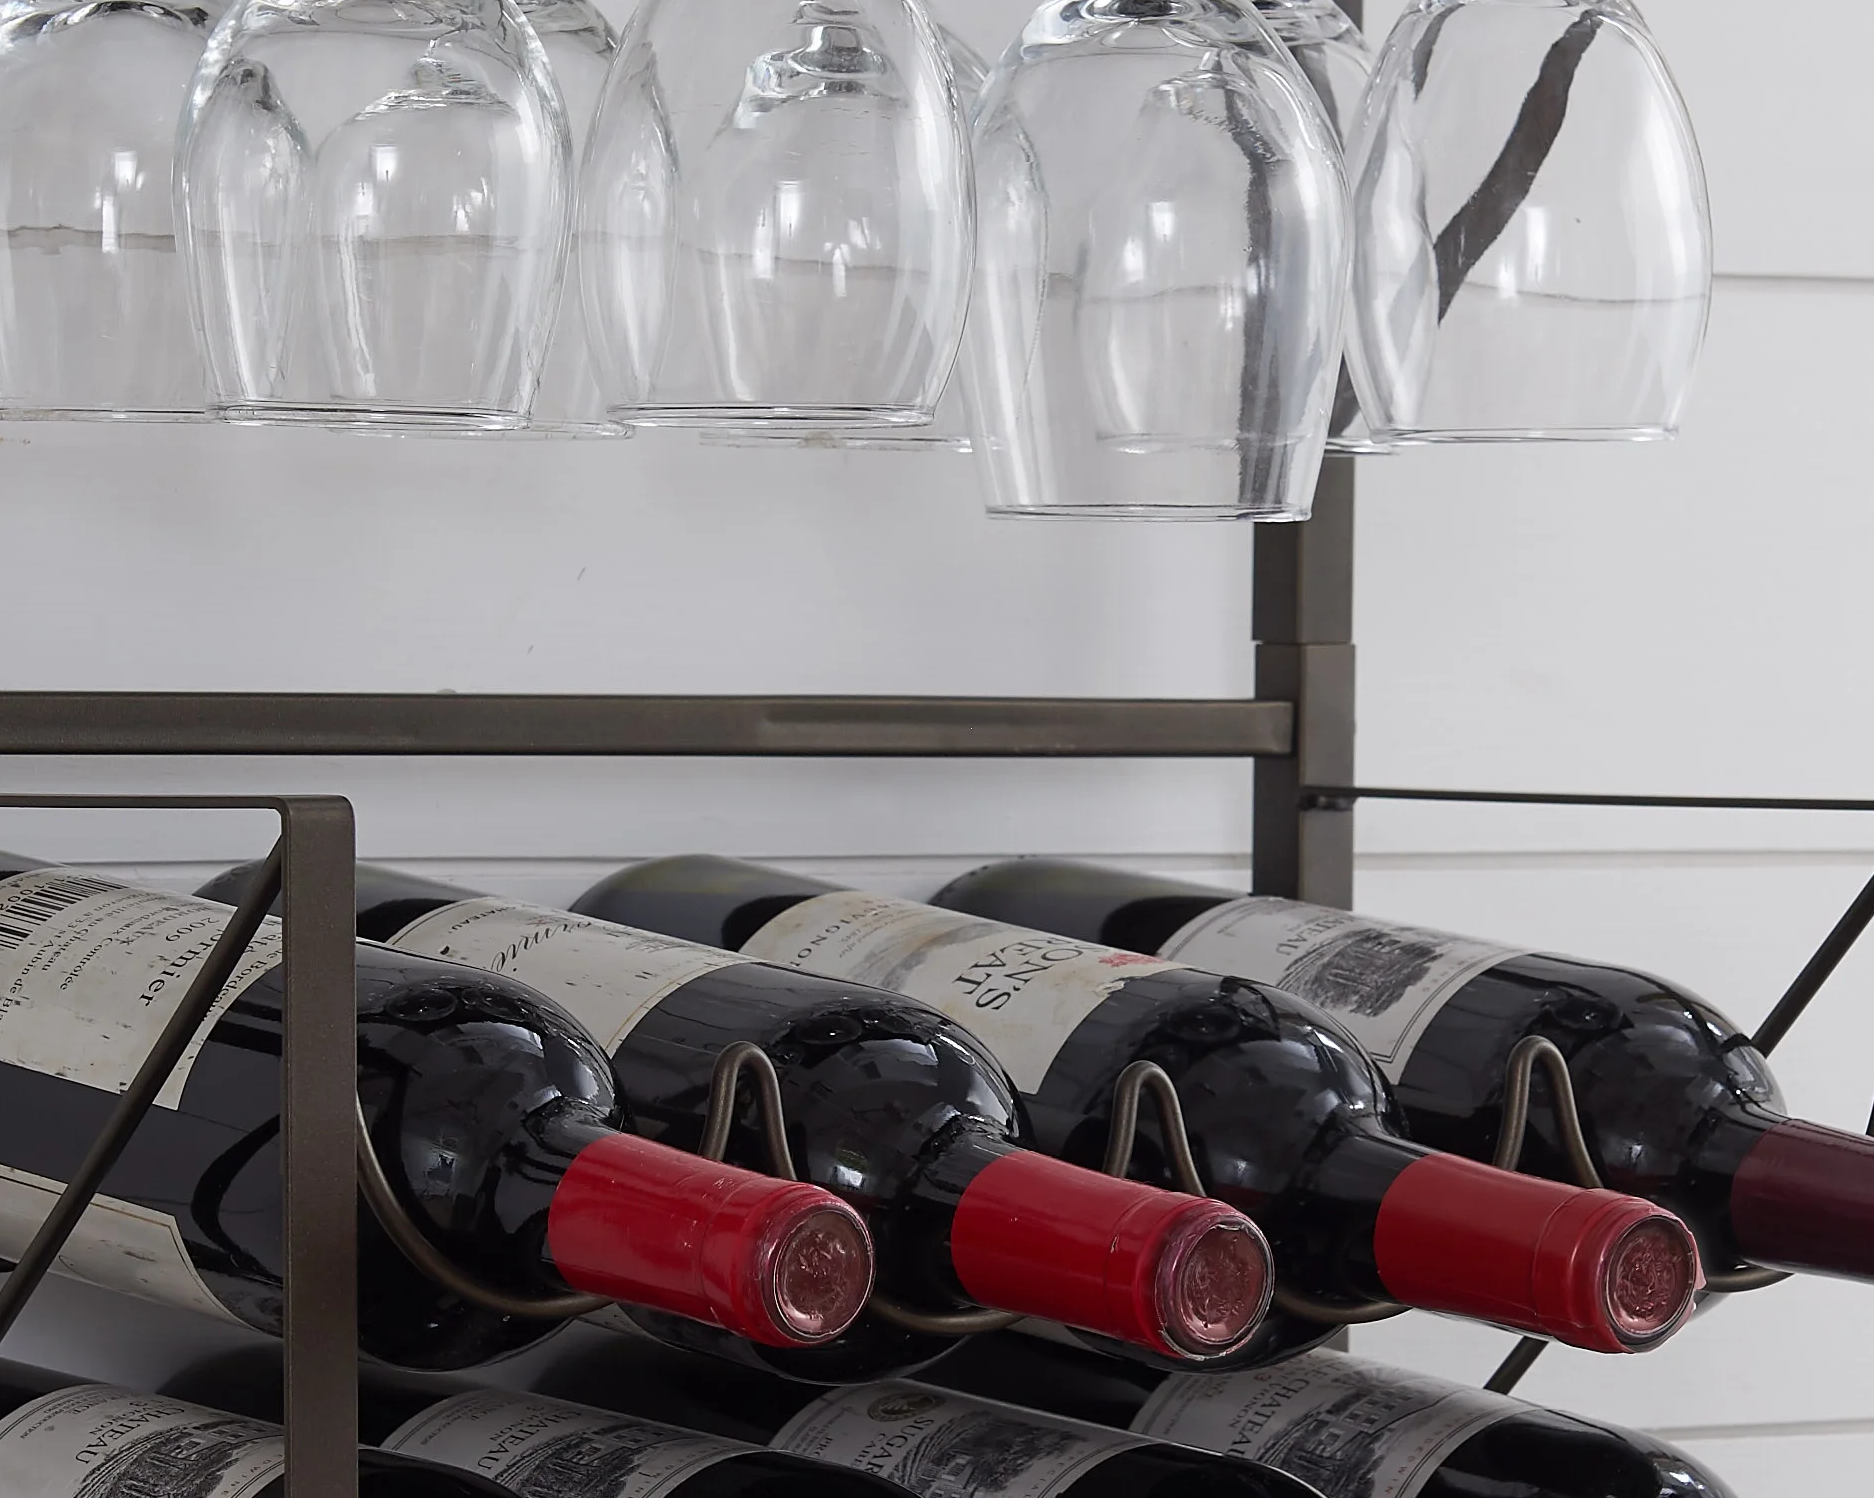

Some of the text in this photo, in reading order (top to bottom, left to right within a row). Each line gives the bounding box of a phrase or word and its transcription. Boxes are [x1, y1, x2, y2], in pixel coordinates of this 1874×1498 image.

[166, 916, 218, 942] 2009
[8, 977, 22, 995] de
[74, 1405, 184, 1466] CHATEAU
[863, 1415, 934, 1476] SUGAR
